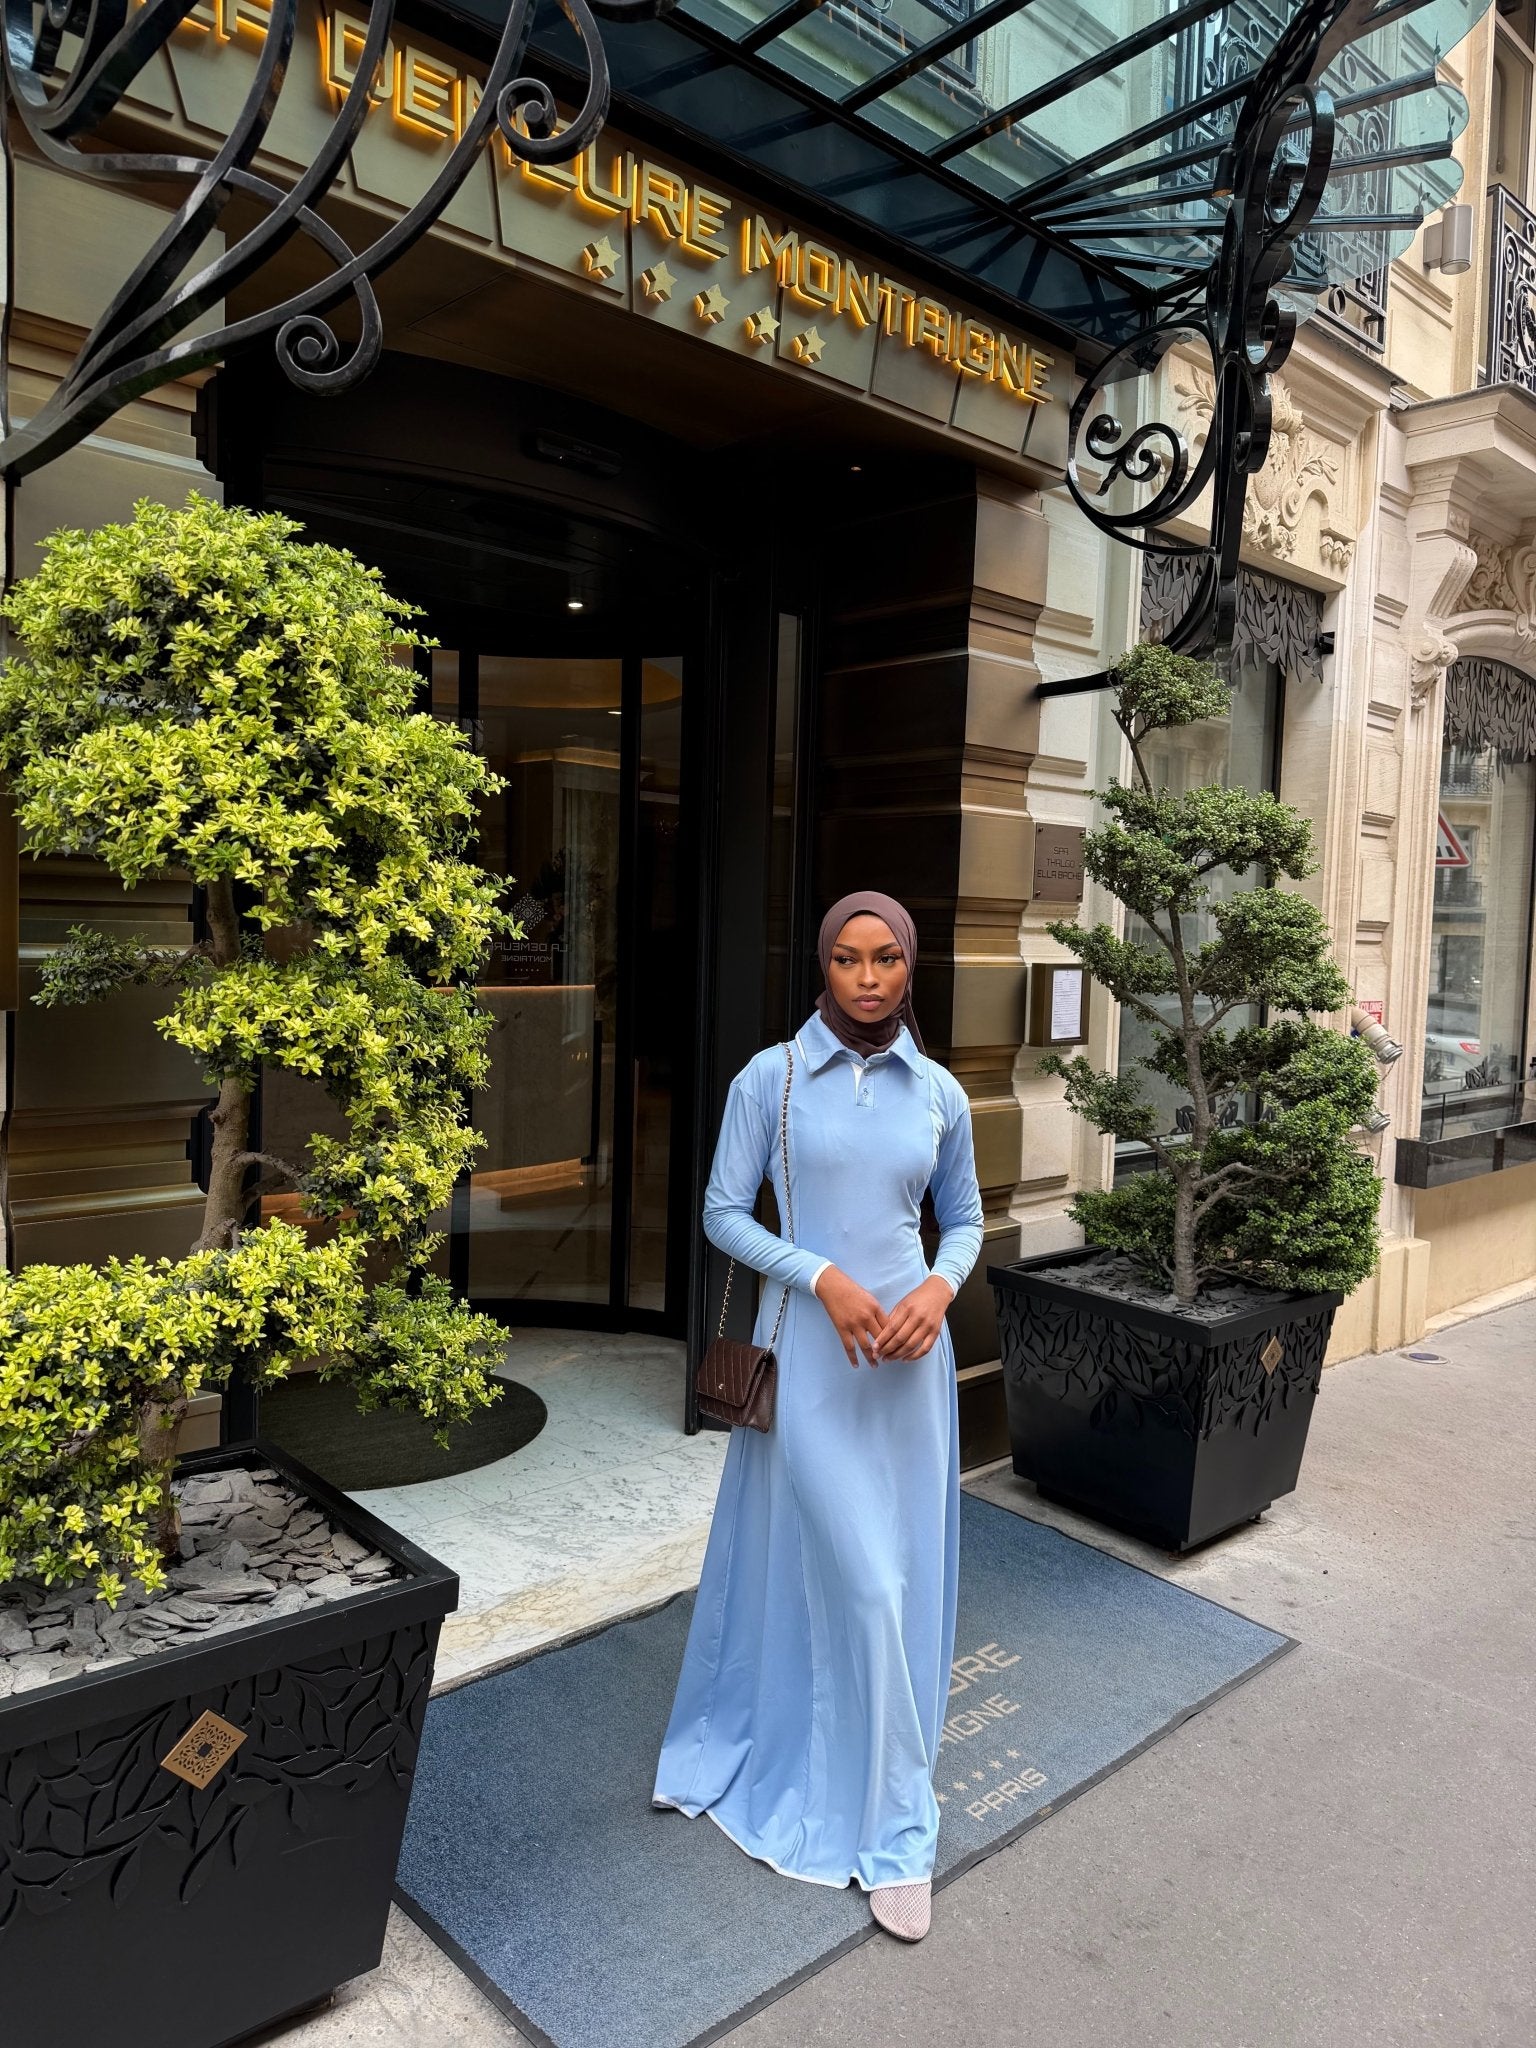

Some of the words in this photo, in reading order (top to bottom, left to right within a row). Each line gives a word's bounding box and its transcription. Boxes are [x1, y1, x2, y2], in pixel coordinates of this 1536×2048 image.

[744, 214, 1055, 404] MONTAIGNE
[1053, 846, 1069, 855] SPA
[1047, 858, 1075, 868] THALGO
[1037, 869, 1057, 879] ELLA
[964, 1768, 1047, 1822] PARIS
